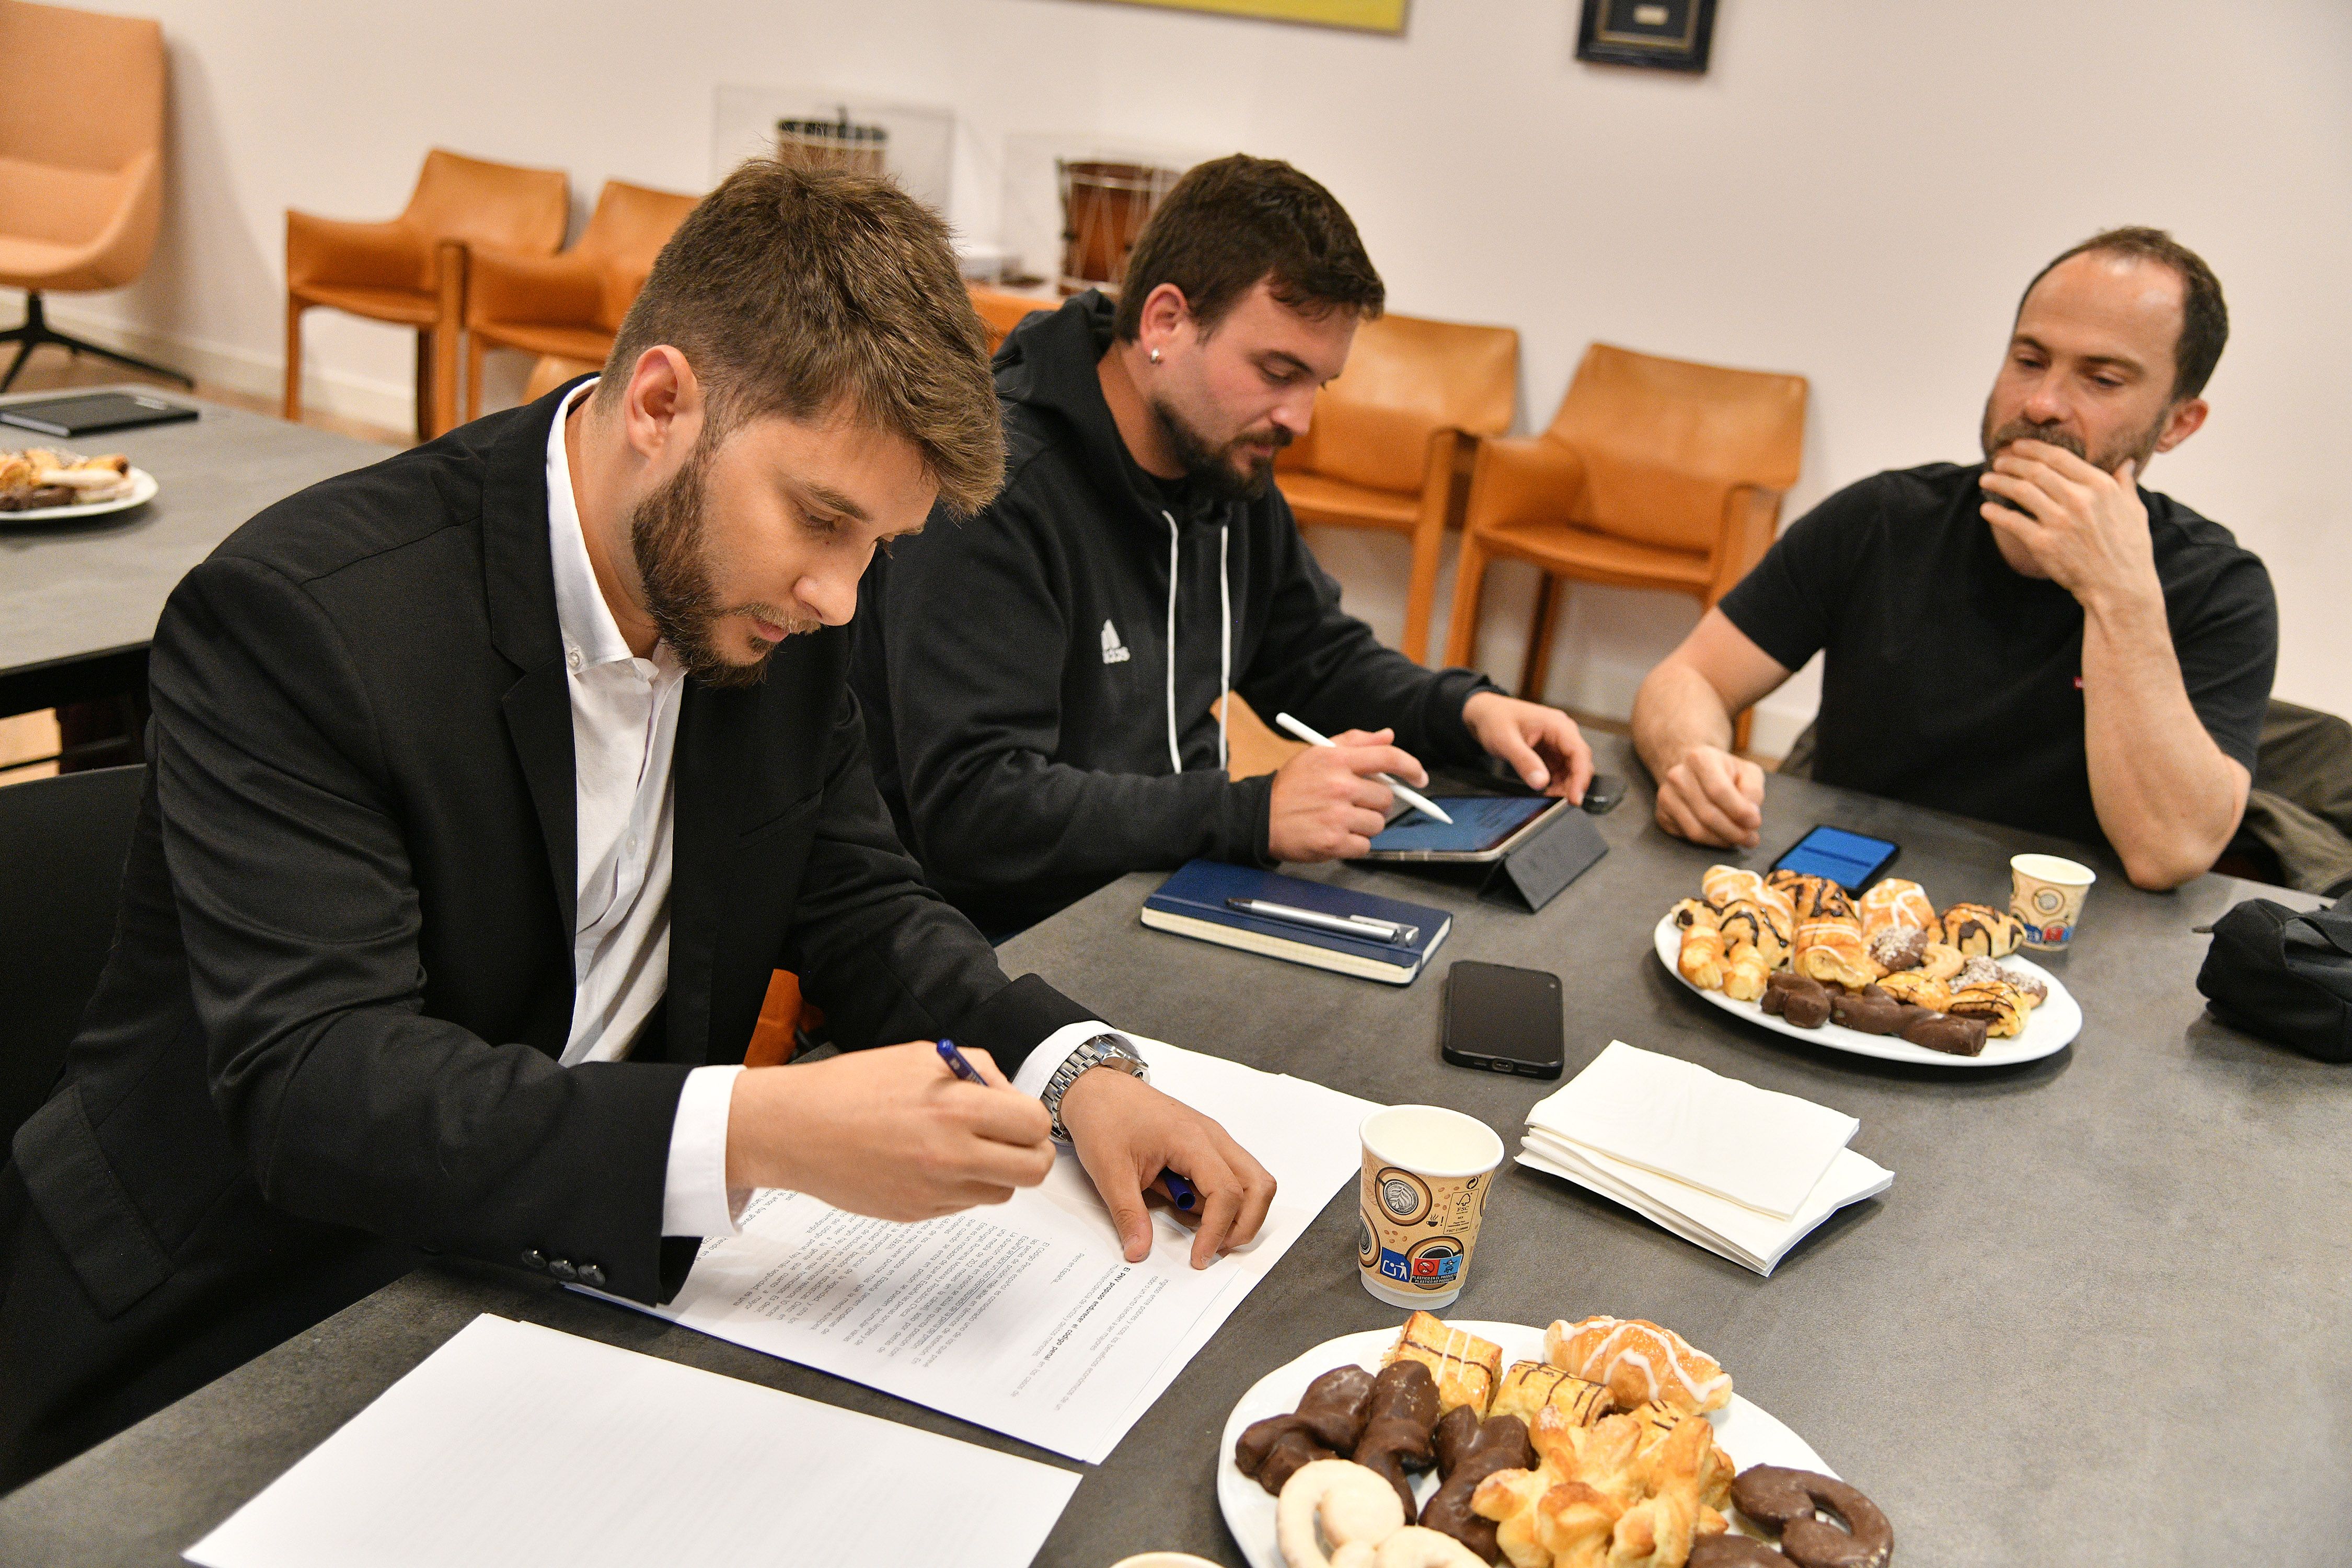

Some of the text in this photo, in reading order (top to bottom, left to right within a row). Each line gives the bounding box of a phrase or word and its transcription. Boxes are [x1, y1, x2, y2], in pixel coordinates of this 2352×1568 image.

[833, 1225, 846, 1235] creer
[920, 1220, 933, 1230] años
[935, 1218, 950, 1229] 48,4%
[944, 1216, 965, 1234] condenas
[975, 1222, 987, 1230] Este
[814, 1225, 831, 1238] código
[868, 1221, 892, 1241] seguridad
[949, 1228, 966, 1242] cuando
[842, 1235, 862, 1251] reclusos
[866, 1233, 892, 1255] percepción
[982, 1238, 997, 1250] media
[1011, 1235, 1029, 1250] España
[802, 1248, 818, 1260] gente
[816, 1250, 832, 1261] veces
[891, 1245, 906, 1258] nueve
[893, 1243, 921, 1269] condenados
[930, 1250, 943, 1260] entra
[946, 1241, 966, 1260] indicador
[1017, 1245, 1031, 1258] penas
[1028, 1247, 1044, 1261] Código
[1072, 1252, 1085, 1262] Pero
[777, 1259, 790, 1268] más
[804, 1261, 817, 1270] más
[837, 1251, 859, 1267] basados
[852, 1256, 867, 1268] social
[874, 1258, 892, 1273] puntos
[965, 1258, 977, 1267] 20,2
[996, 1254, 1010, 1264] hace
[807, 1263, 831, 1281] términos
[930, 1265, 941, 1274] que
[938, 1261, 961, 1279] Moldavia
[950, 1268, 966, 1282] meses
[996, 1264, 1012, 1278] prisión
[1016, 1262, 1031, 1274] Penal
[770, 1273, 788, 1287] cuanto
[863, 1274, 875, 1283] más
[906, 1268, 924, 1283] prisión
[1000, 1274, 1017, 1290] español
[1114, 1272, 1125, 1282] PNV
[852, 1284, 864, 1292] que
[868, 1276, 889, 1291] España
[908, 1280, 927, 1295] España
[986, 1279, 998, 1288] más
[1097, 1282, 1115, 1299] propuso
[852, 1292, 870, 1306] tienen
[881, 1289, 901, 1306] pueden
[899, 1238, 1011, 1346] duración media prisión sitúa quinta posición
[914, 1283, 939, 1303] República
[955, 1278, 985, 1306] desmesurado
[975, 1289, 988, 1299] altas
[831, 1298, 848, 1311] media
[887, 1300, 904, 1315] penas
[969, 1296, 996, 1321] considerado
[1077, 1301, 1098, 1322] endurecer
[828, 1307, 854, 1327] condenas
[859, 1308, 882, 1328] acumular
[879, 1314, 890, 1323] son
[910, 1312, 921, 1321] solo
[932, 1316, 947, 1328] pena
[949, 1307, 971, 1327] términos
[901, 1321, 910, 1330] por
[959, 1322, 970, 1331] uno
[1056, 1329, 1073, 1345] código
[1043, 1346, 1058, 1361] penal
